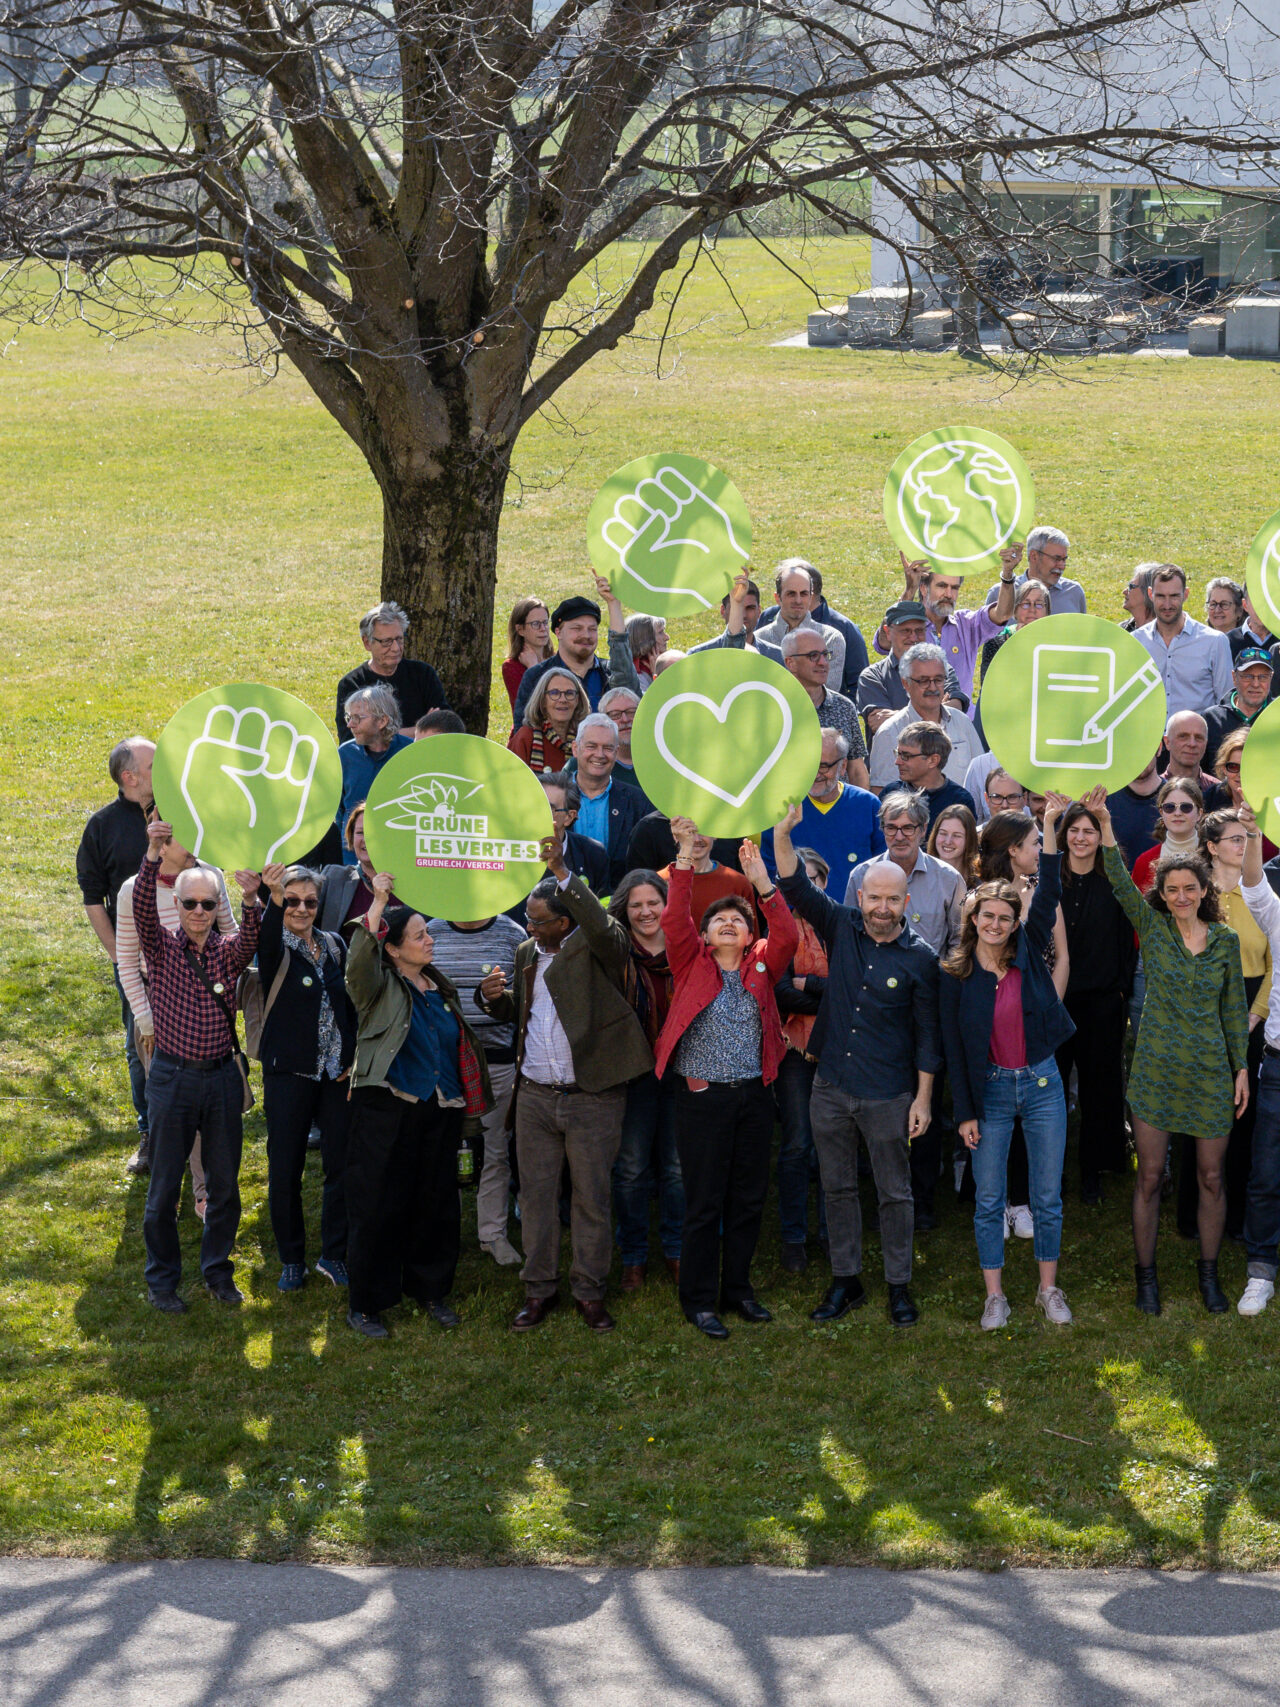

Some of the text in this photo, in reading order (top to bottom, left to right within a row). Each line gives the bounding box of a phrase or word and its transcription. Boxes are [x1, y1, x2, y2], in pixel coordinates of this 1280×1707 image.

[419, 815, 484, 833] GRÜNE
[419, 838, 537, 859] LES VERT·E·S
